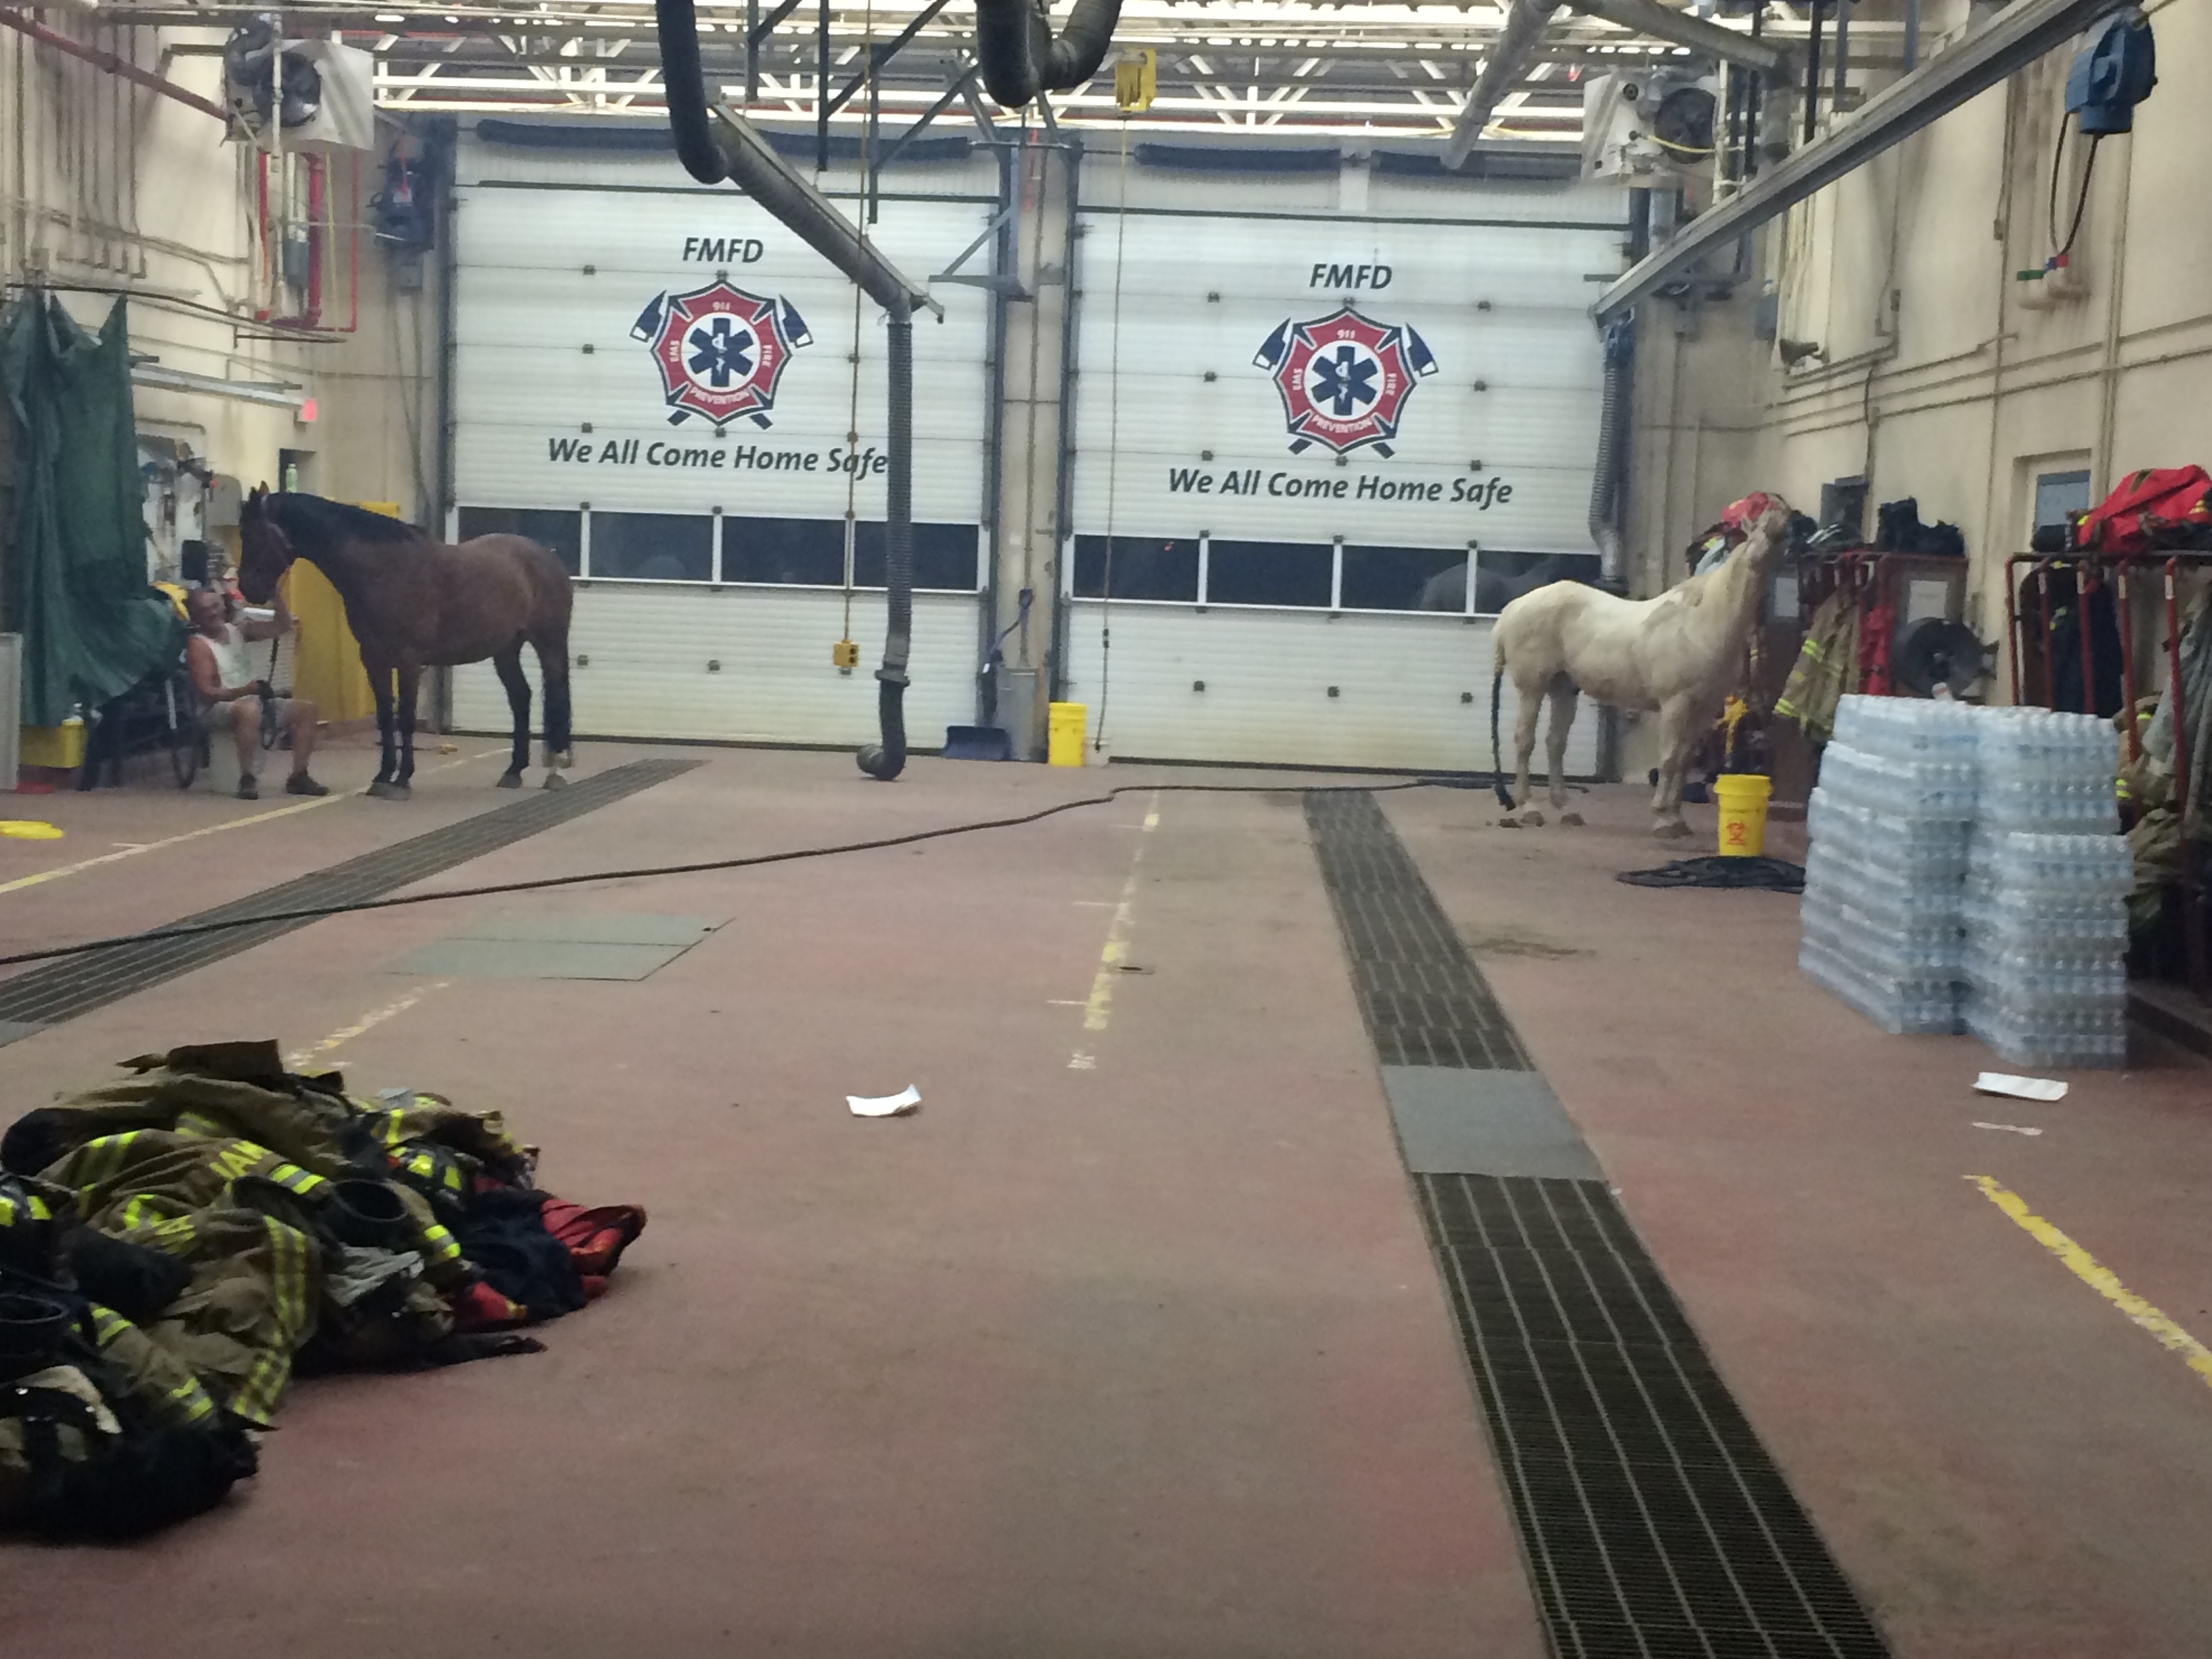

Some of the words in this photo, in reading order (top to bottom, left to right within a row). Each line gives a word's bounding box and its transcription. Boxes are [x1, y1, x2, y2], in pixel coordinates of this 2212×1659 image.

[683, 238, 762, 263] FMFD
[1311, 264, 1392, 289] FMFD
[712, 301, 731, 311] 911
[1336, 329, 1355, 339] 911
[670, 340, 680, 363] EMS
[762, 344, 773, 368] FIRE
[1292, 368, 1303, 391] EMS
[1385, 373, 1397, 396] FIRE
[689, 386, 750, 405] PREVENTION
[1311, 415, 1374, 433] PREVENTION
[549, 438, 592, 463] We
[599, 440, 638, 464] All
[647, 443, 725, 468] Come
[734, 446, 817, 471] Home
[827, 448, 888, 480] Safe
[1170, 468, 1213, 493] We
[1219, 470, 1261, 495] All
[1268, 472, 1348, 498] Come
[1357, 476, 1443, 501] Home
[1451, 478, 1513, 510] Safe
